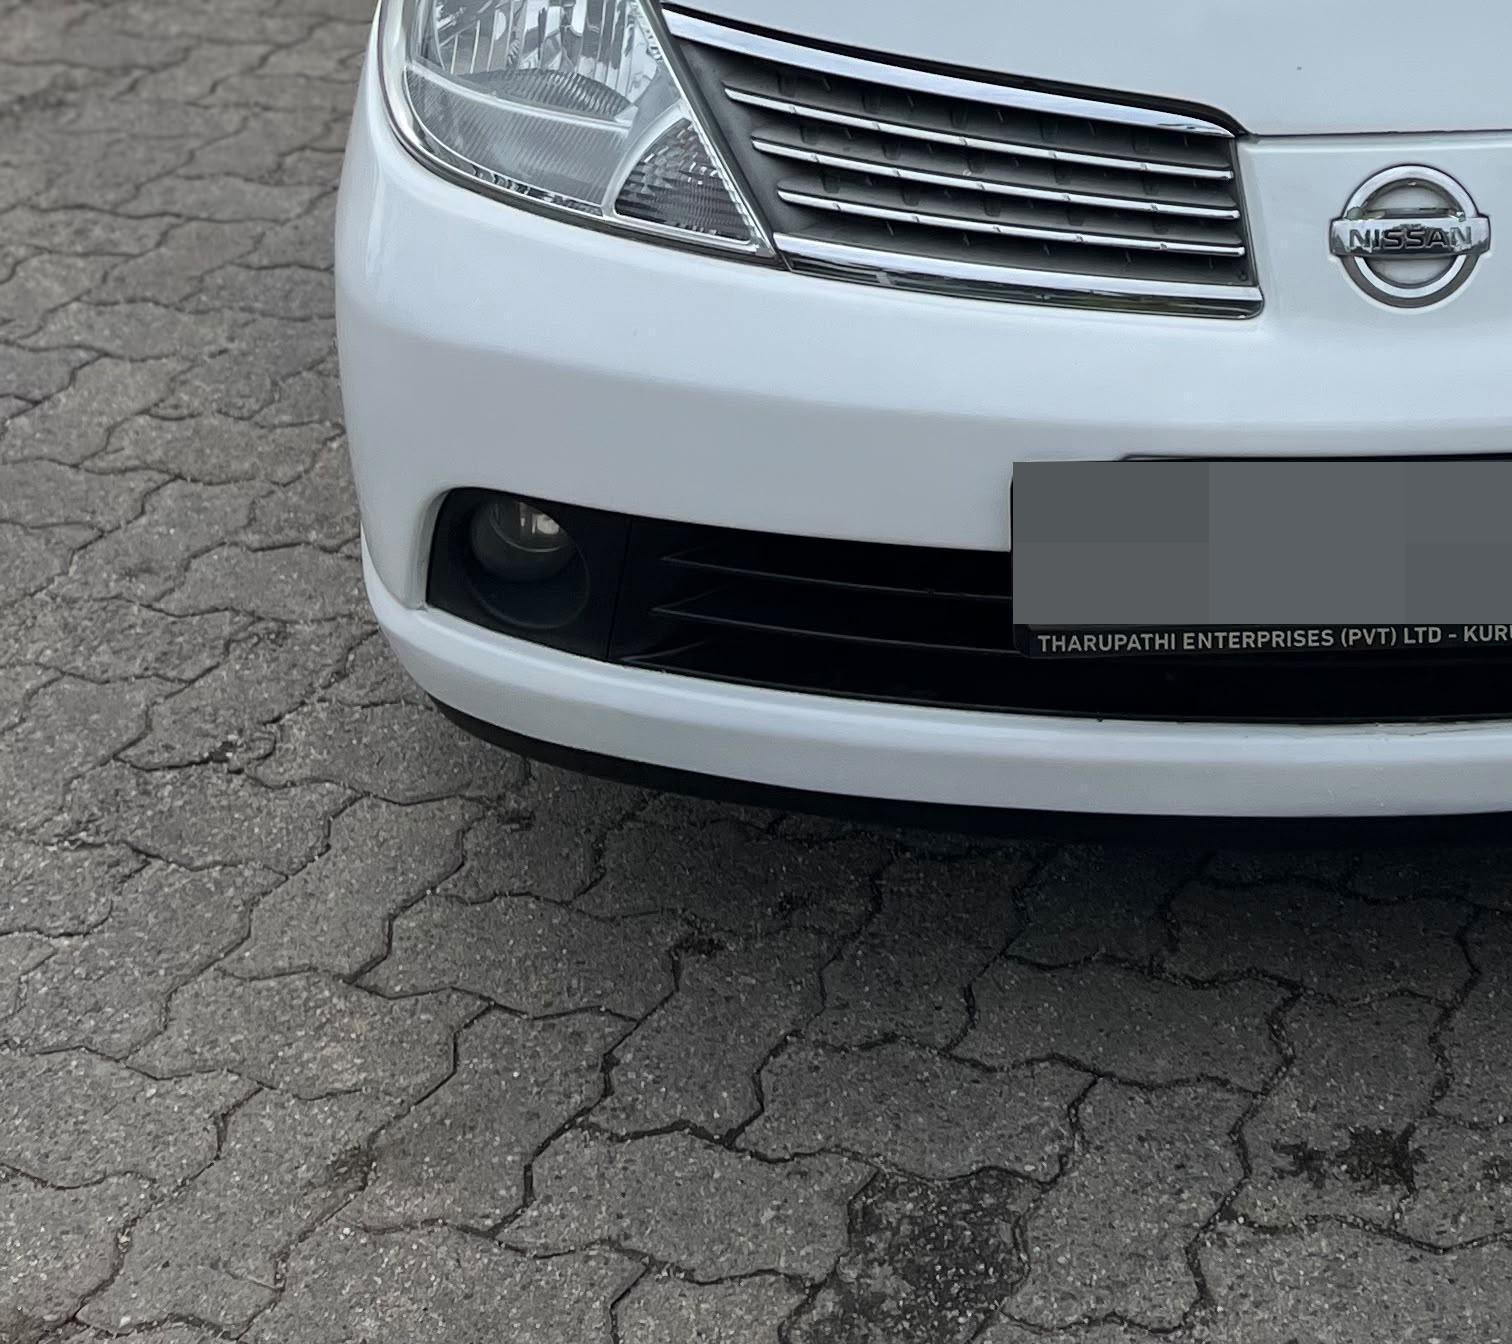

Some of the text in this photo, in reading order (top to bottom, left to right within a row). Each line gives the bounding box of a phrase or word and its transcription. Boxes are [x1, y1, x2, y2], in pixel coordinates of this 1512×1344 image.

[1348, 226, 1472, 250] NISSAN
[1038, 633, 1176, 653] THARUPATHI
[1182, 629, 1334, 650] ENTERPRISES
[1340, 627, 1397, 647] (PVT)
[1403, 626, 1442, 644] LTD
